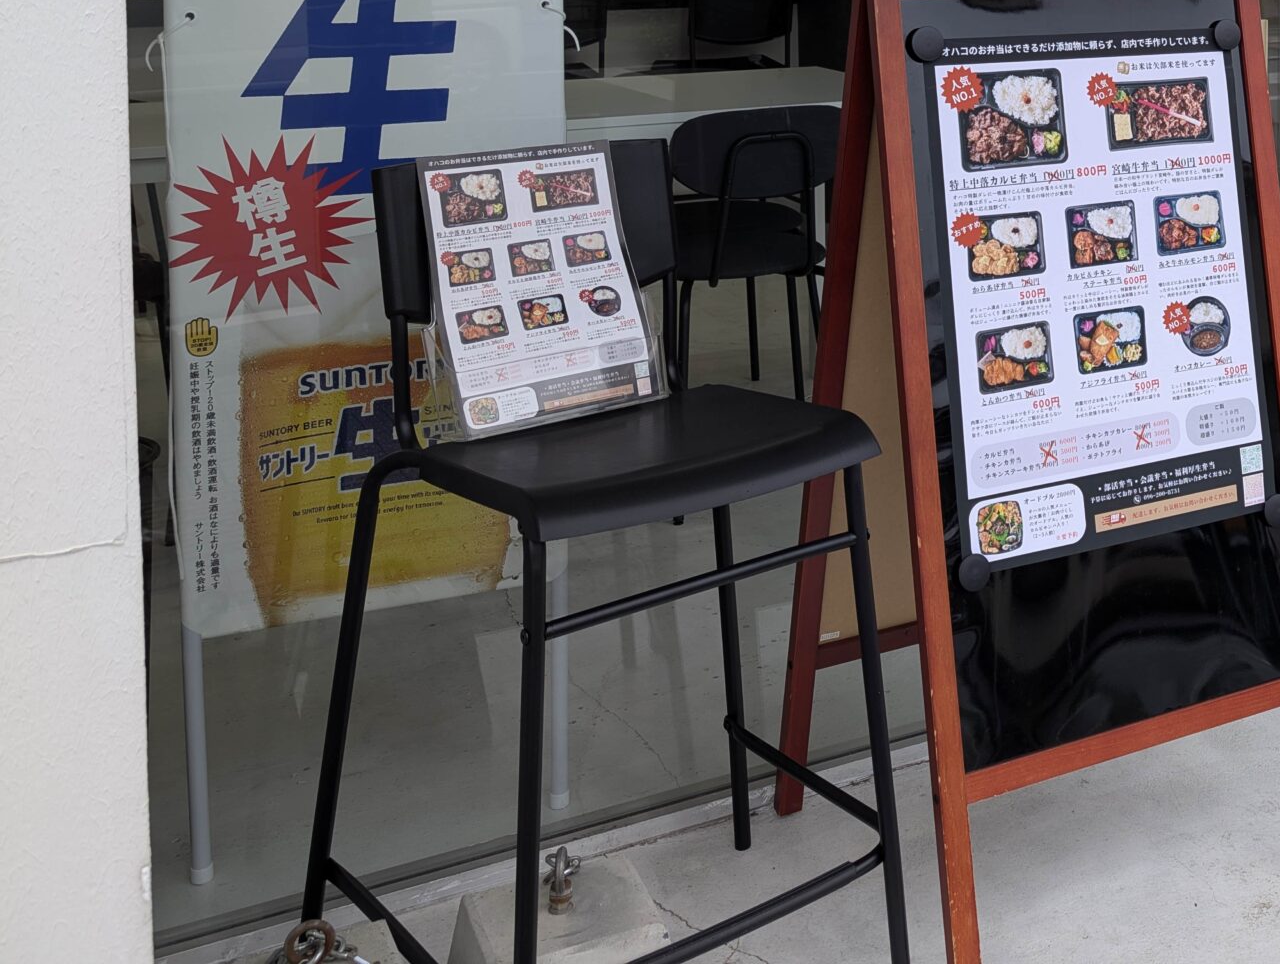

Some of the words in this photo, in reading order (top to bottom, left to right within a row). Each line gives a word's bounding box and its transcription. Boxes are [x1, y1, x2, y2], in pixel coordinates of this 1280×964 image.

[952, 76, 971, 91] 人気
[1094, 79, 1109, 92] 人気
[952, 88, 977, 104] NO.1
[1093, 88, 1114, 103] NO.2
[1112, 160, 1159, 174] 宮崎牛弁当
[1198, 153, 1231, 166] 1000円
[949, 171, 1038, 190] 特上中落カルビ弁当
[1077, 164, 1107, 177] 800円
[231, 177, 307, 276] 樽生
[953, 221, 981, 238] おすすめ
[1212, 262, 1236, 273] 600円
[1123, 274, 1147, 285] 600円
[972, 281, 1014, 294] からあげ弁当
[1020, 288, 1046, 300] 500円
[1170, 307, 1184, 320] 人気
[1168, 316, 1188, 330] NO.3
[1174, 361, 1211, 373] オハコカレー
[1224, 363, 1248, 376] 500円
[1079, 374, 1127, 390] アジフライ弁当
[1135, 378, 1160, 391] 500円
[981, 392, 1022, 407] とんかつ弁当
[1032, 396, 1061, 410] 600円
[259, 424, 299, 440] SUNTORY
[303, 418, 333, 431] BEER
[1086, 440, 1110, 450] からあげ
[984, 448, 1015, 459] カルビ弁当
[1087, 447, 1122, 460] ポテトフライ
[258, 446, 330, 482] サントリー
[1023, 493, 1055, 505] オードブル
